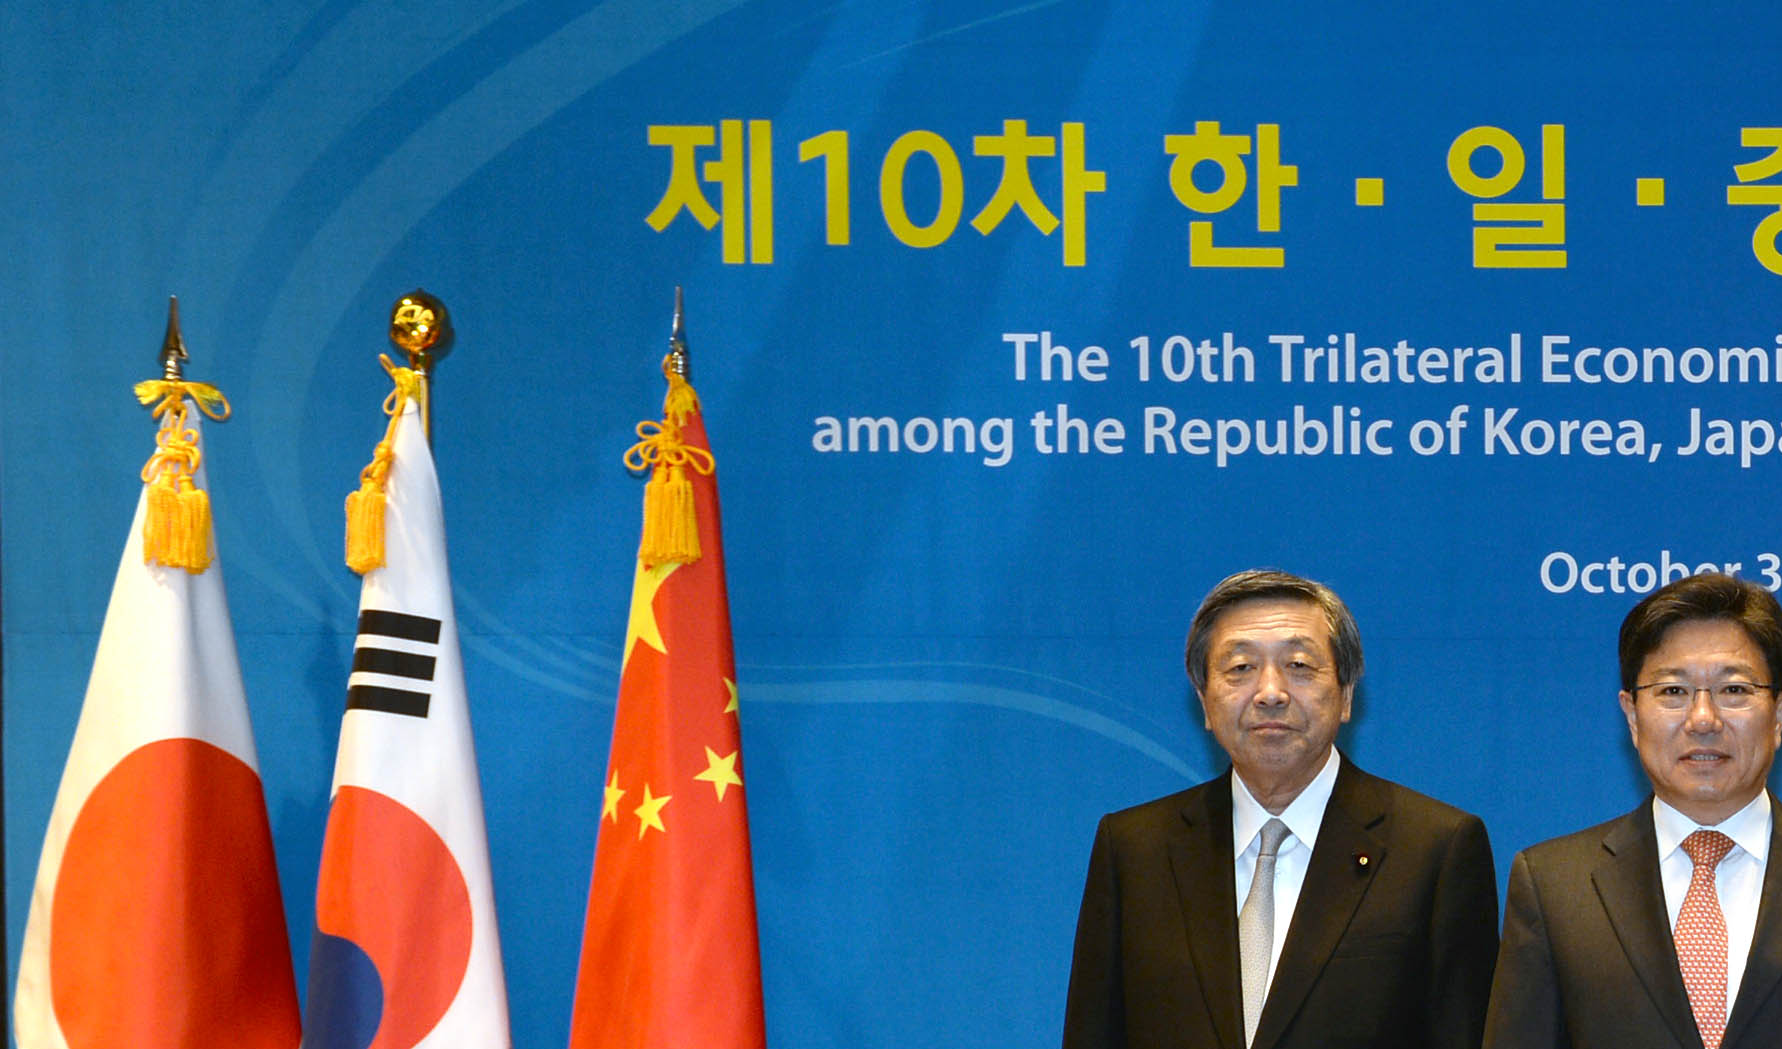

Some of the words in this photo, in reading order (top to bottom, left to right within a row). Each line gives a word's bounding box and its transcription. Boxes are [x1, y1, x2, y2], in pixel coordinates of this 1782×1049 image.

[646, 119, 1107, 267] 제10차
[1165, 120, 1299, 268] 한
[1447, 123, 1568, 269] 일
[1002, 331, 1109, 382] The
[1130, 332, 1255, 383] 10th
[1268, 333, 1521, 383] Trilateral
[812, 416, 1013, 467] among
[1030, 403, 1126, 454] the
[1144, 405, 1393, 468] Republic
[1409, 404, 1469, 456] of
[1484, 407, 1662, 463] Korea,
